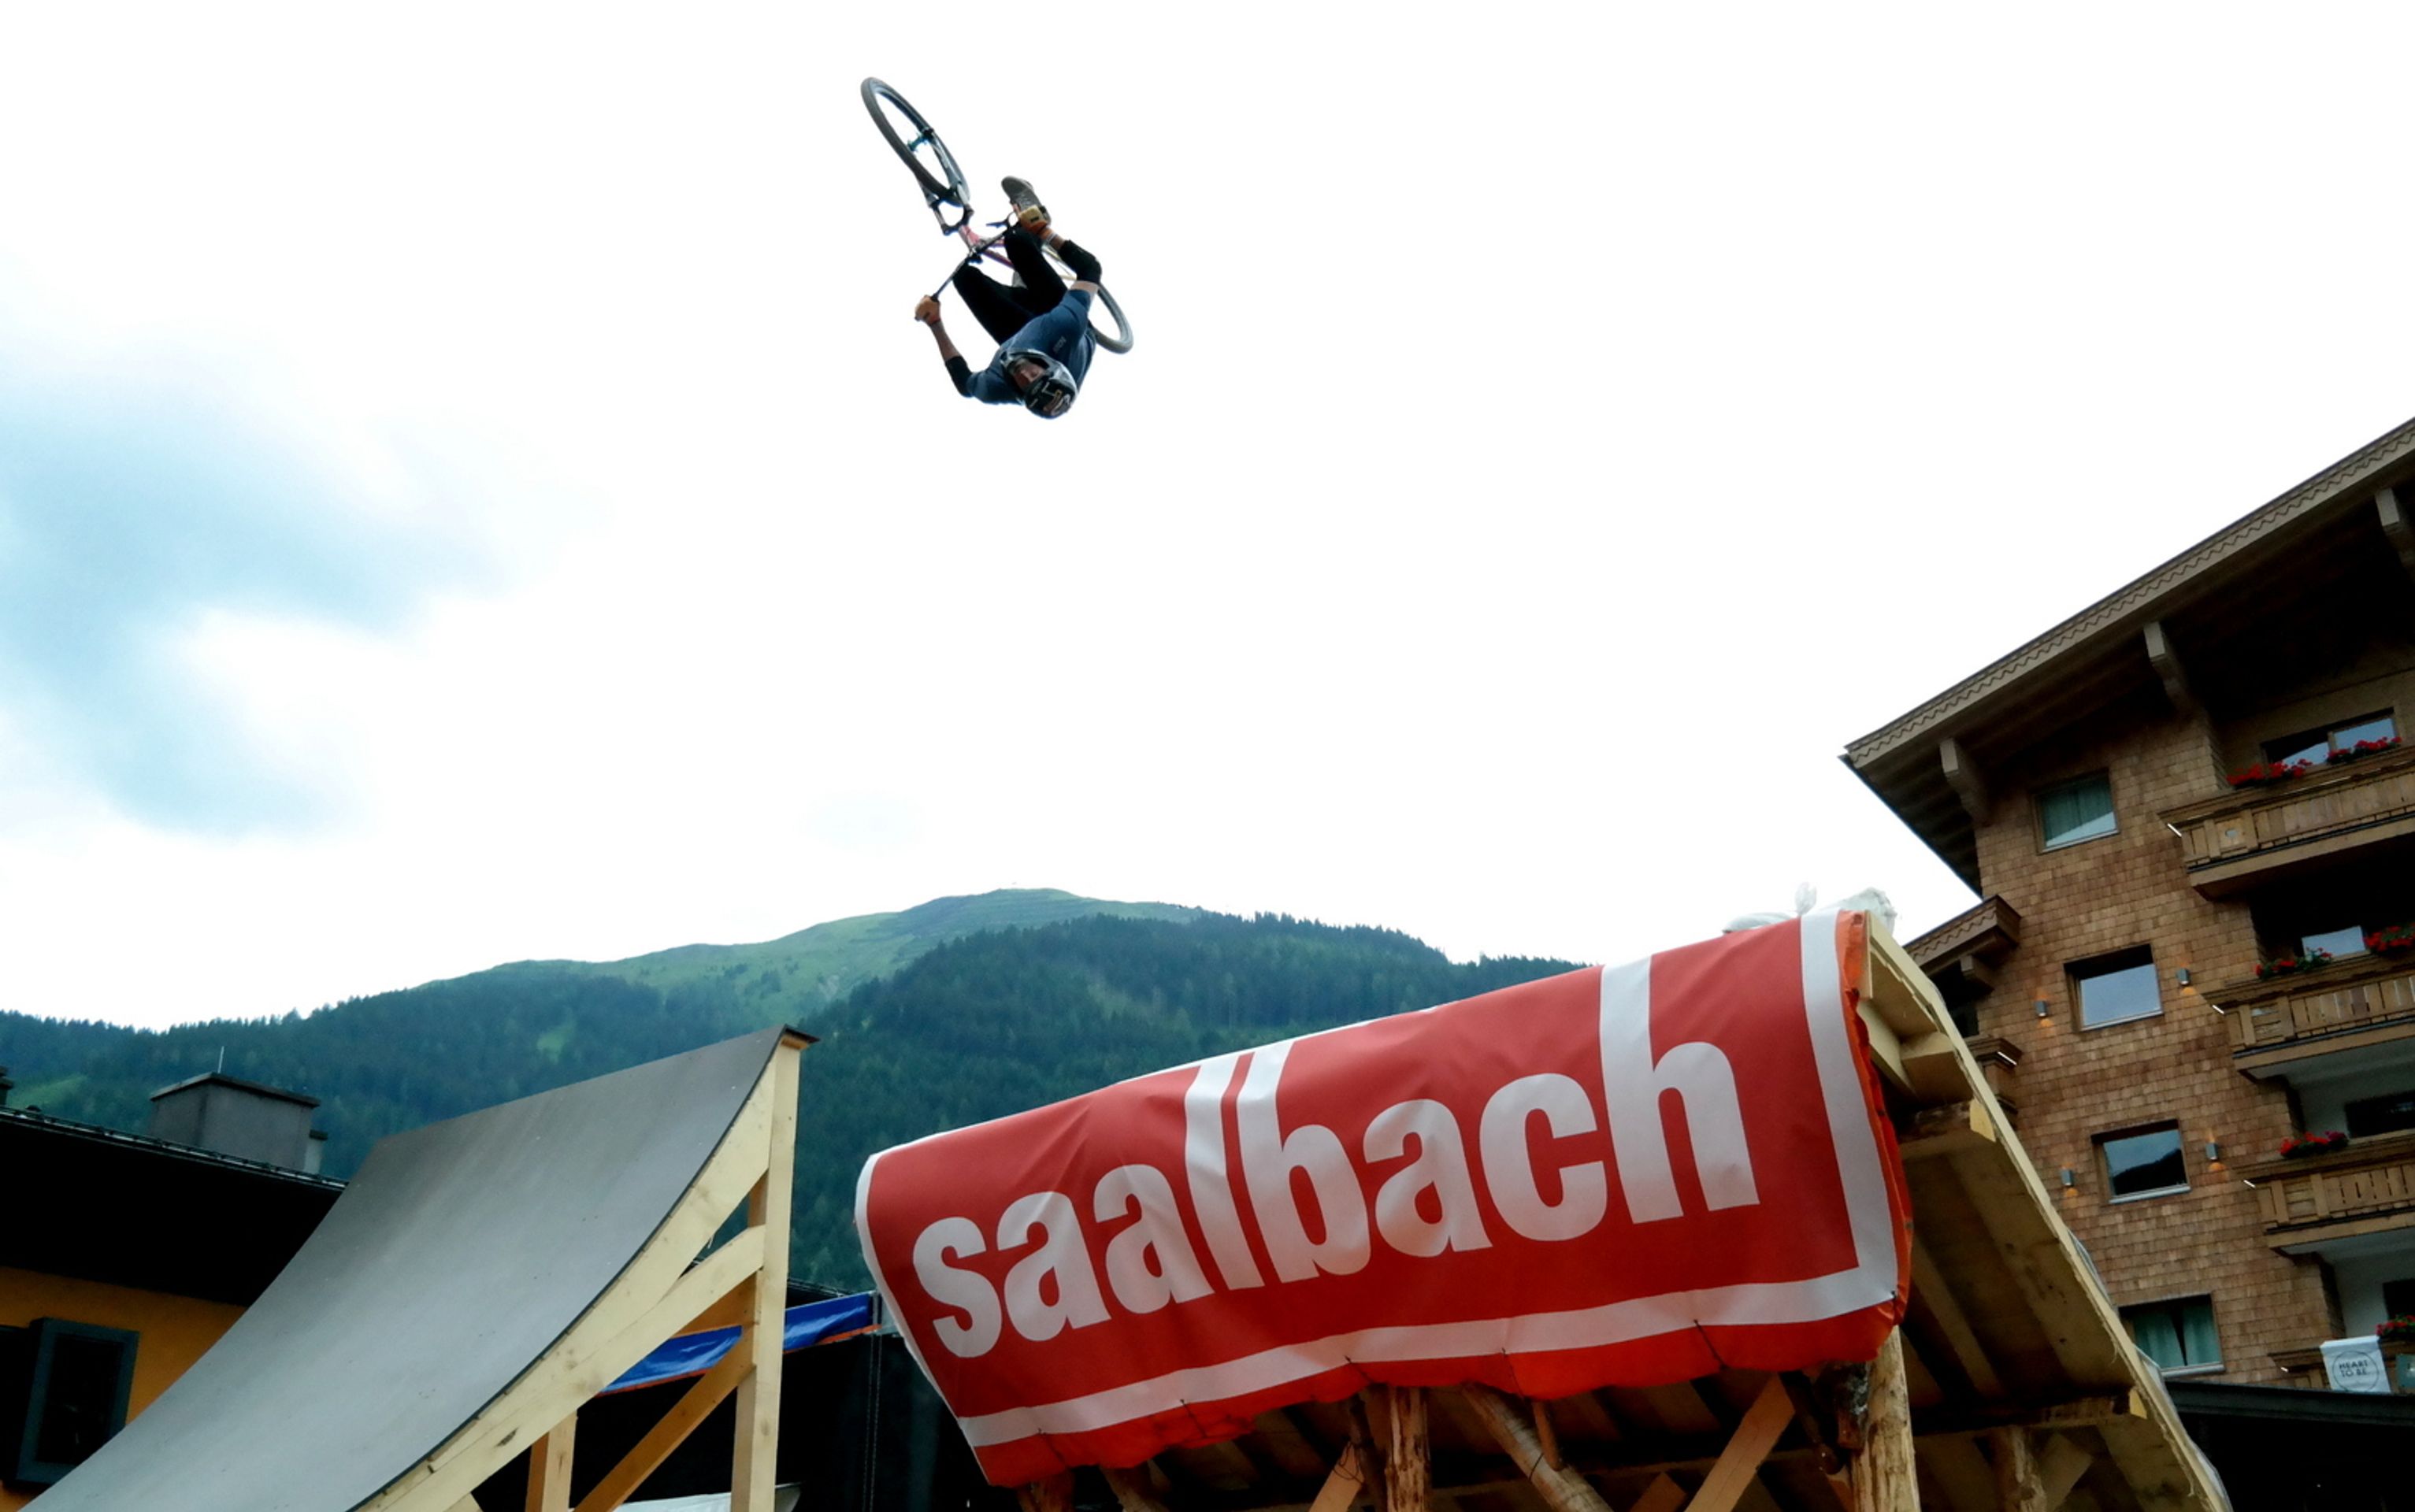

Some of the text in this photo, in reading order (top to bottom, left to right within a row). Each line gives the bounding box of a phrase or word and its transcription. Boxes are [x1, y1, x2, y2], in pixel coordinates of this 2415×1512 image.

[913, 956, 1759, 1358] saalbach
[2339, 1360, 2368, 1369] HEART
[2340, 1369, 2354, 1377] TO
